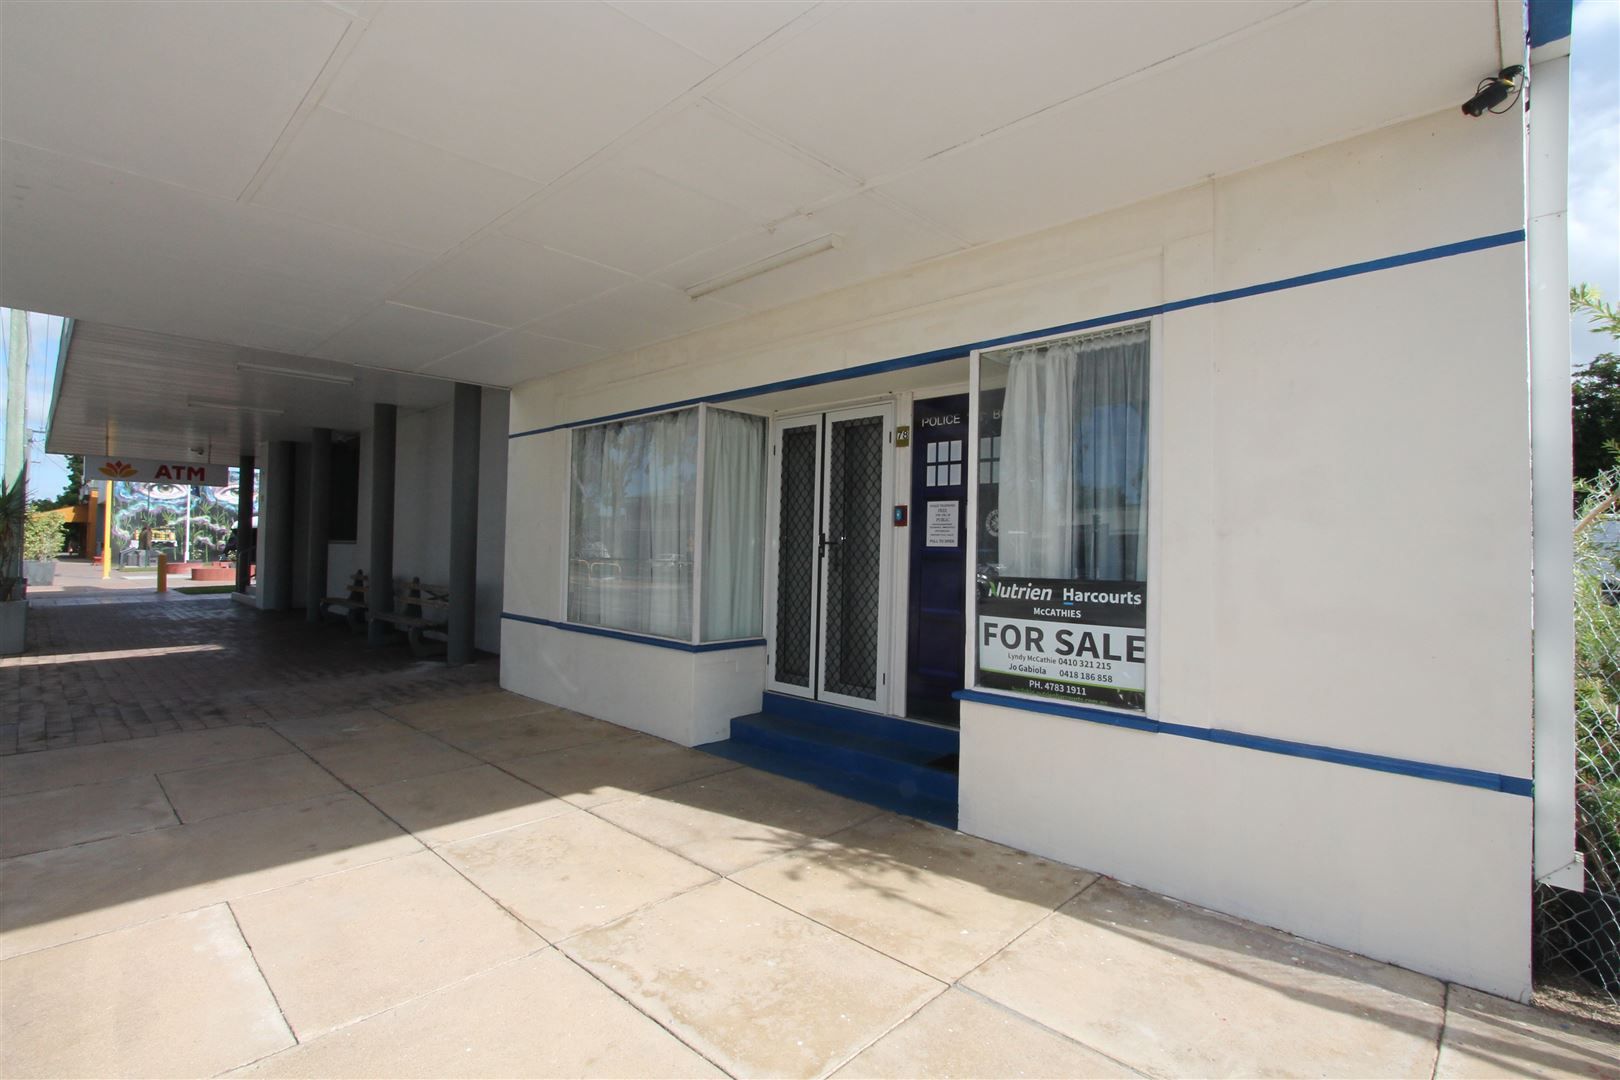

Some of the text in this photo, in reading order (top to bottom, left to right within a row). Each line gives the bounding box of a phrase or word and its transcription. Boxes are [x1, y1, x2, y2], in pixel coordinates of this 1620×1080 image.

[921, 414, 961, 427] POLICE
[896, 430, 909, 440] 78
[154, 464, 206, 482] ATM
[988, 582, 1053, 601] Nutrien
[1062, 587, 1142, 605] Harcourts
[1033, 607, 1082, 619] McCATHIES
[983, 622, 1146, 664] FOR SALE
[1007, 652, 1112, 671] Lyndy McCathie 0410 321 215
[1008, 663, 1113, 683] Jo Gabiola 0418 186 858
[1028, 679, 1043, 690] PH.
[1044, 682, 1065, 693] 4783
[1066, 685, 1087, 696] 1911
